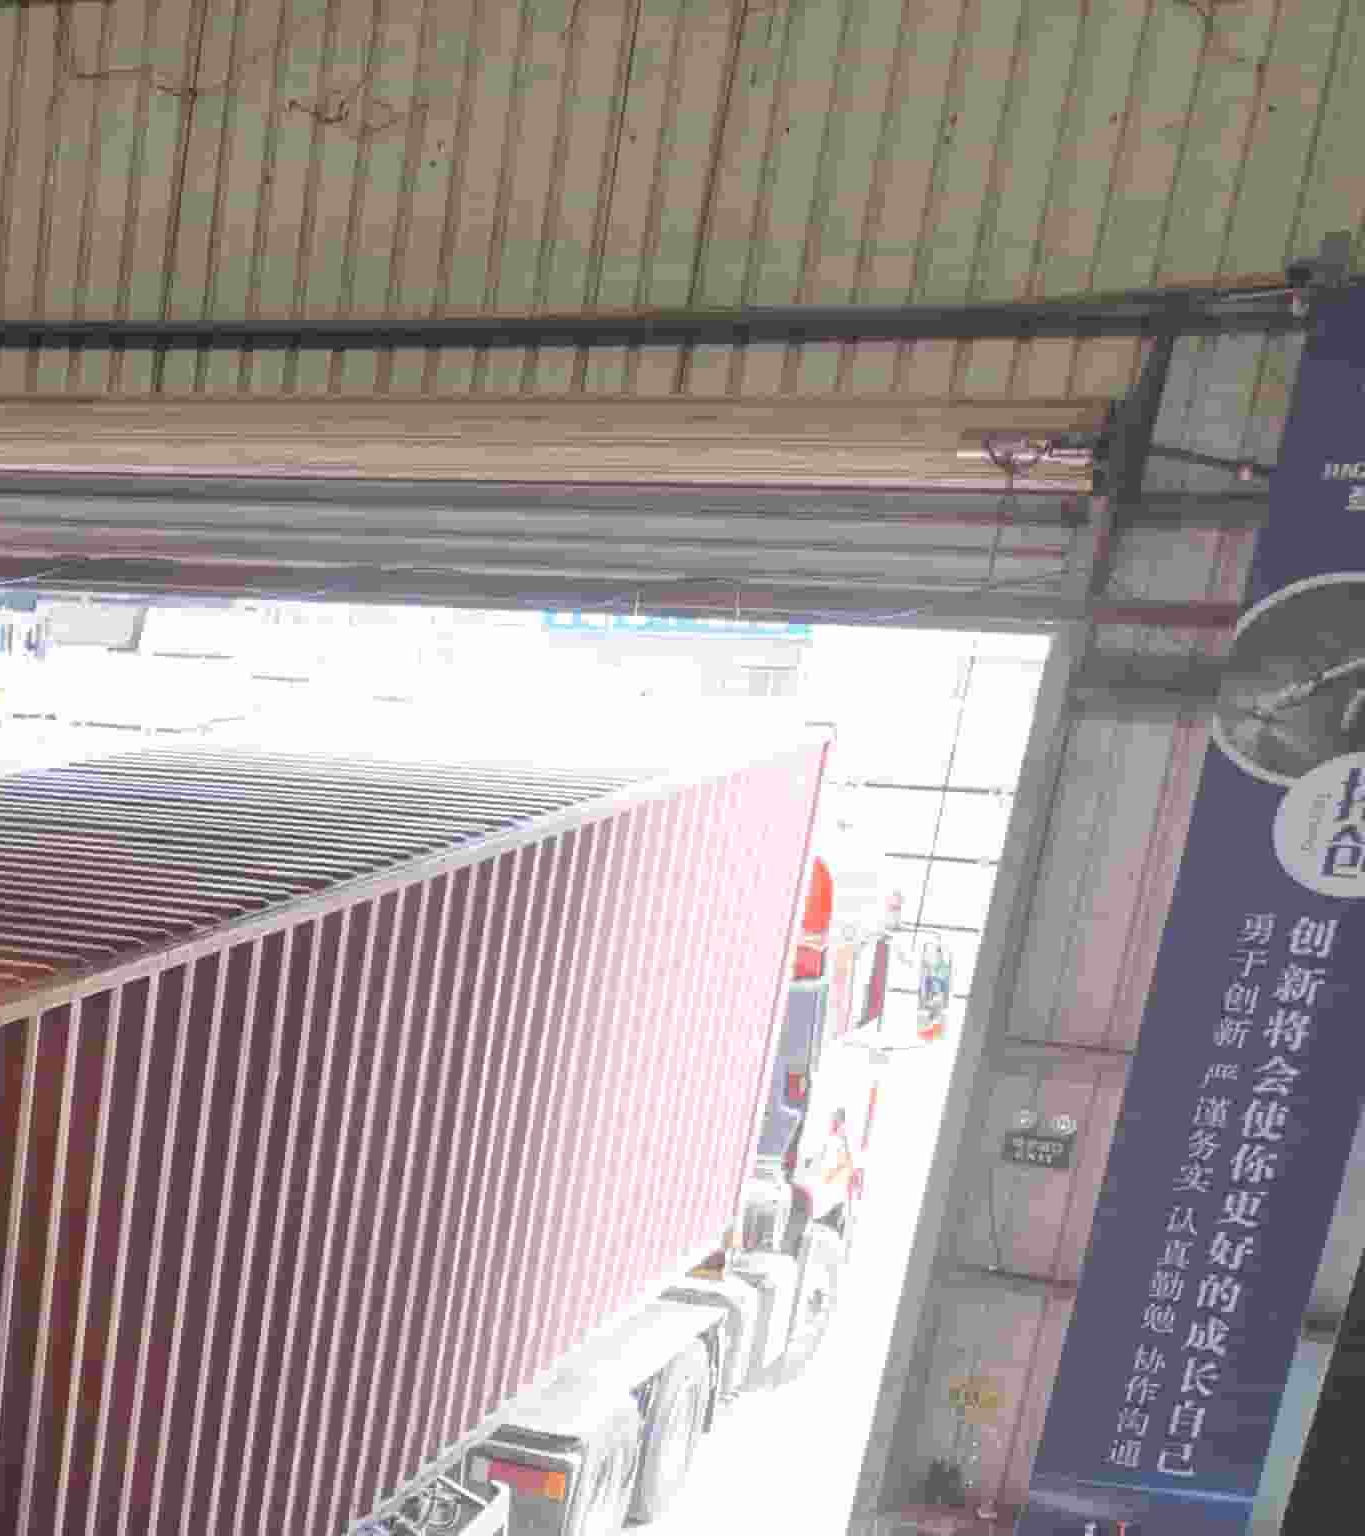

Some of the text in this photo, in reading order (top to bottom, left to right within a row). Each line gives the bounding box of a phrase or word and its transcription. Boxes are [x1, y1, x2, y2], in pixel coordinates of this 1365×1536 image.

[1157, 917, 1338, 1476] 创新将会使你更好的成长自己
